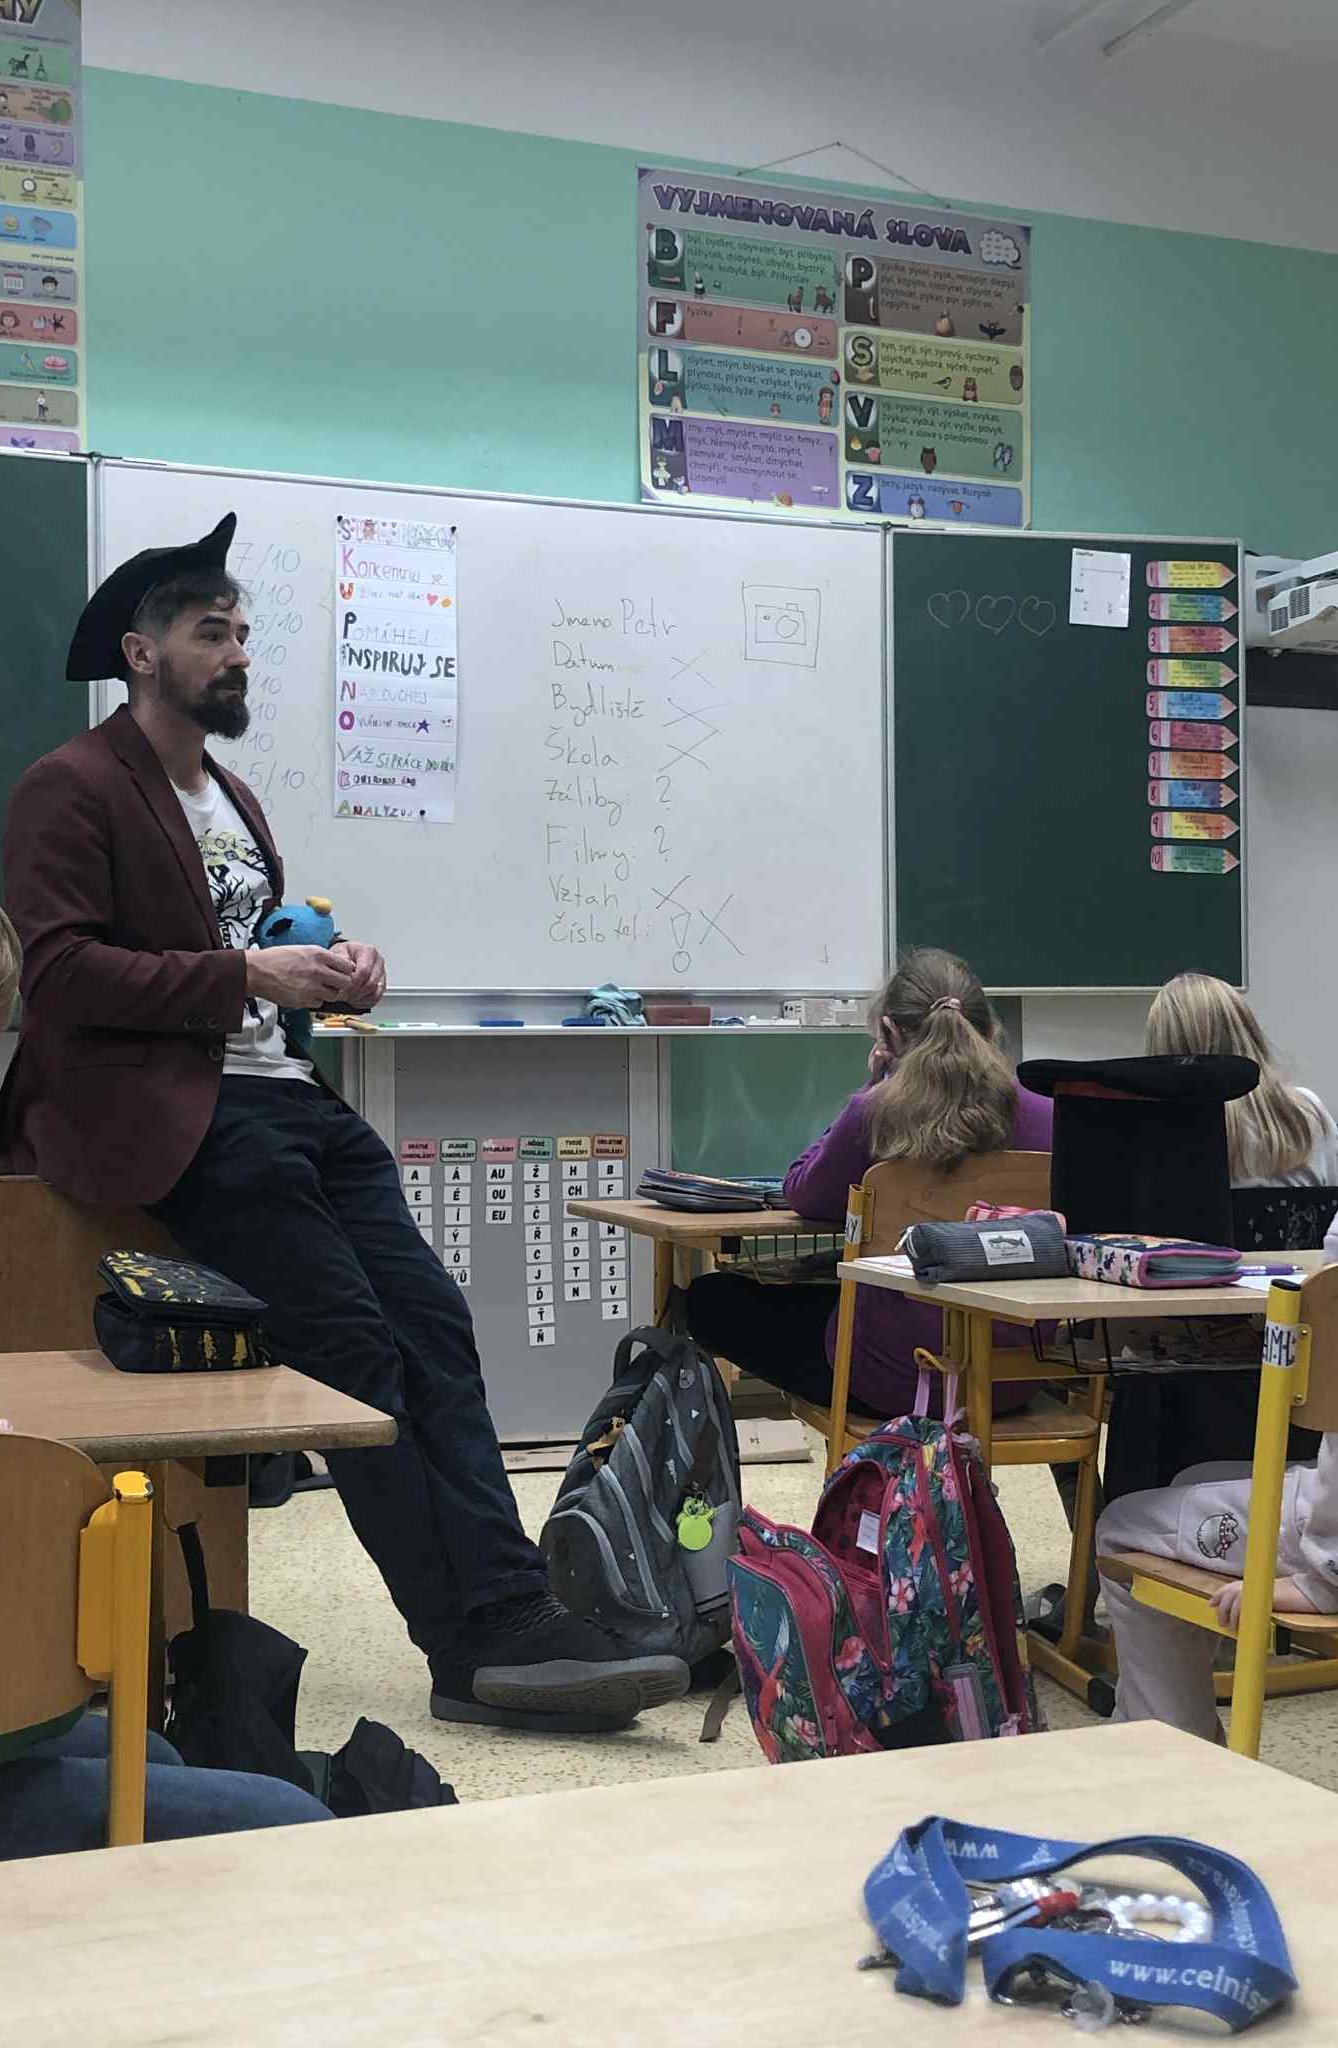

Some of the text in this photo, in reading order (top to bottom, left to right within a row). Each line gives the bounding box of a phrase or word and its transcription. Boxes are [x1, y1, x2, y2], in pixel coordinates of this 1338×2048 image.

[652, 185, 972, 254] VYJMENOVANÁ SLOVA
[655, 229, 679, 261] B
[852, 257, 874, 289] P
[656, 301, 677, 334] F
[851, 335, 874, 367] S
[658, 349, 678, 382] L
[848, 394, 875, 428] V
[652, 418, 684, 451] M
[852, 474, 874, 506] Z
[235, 542, 302, 576] 7/10
[621, 597, 678, 638] Petr
[429, 655, 456, 678] SE
[551, 682, 647, 727] Bydliště
[411, 1170, 419, 1181] A
[452, 1168, 460, 1181] Á
[491, 1169, 505, 1180] AU
[533, 1165, 539, 1177] Ž
[569, 1165, 577, 1176] H
[607, 1165, 613, 1175] B
[414, 1191, 422, 1201] E
[453, 1188, 460, 1201] É
[492, 1189, 506, 1200] OU
[534, 1186, 540, 1199] Š
[568, 1185, 582, 1196] CH
[607, 1185, 613, 1194] F
[417, 1211, 421, 1222] I
[456, 1208, 460, 1222] Í
[492, 1210, 506, 1221] EU
[533, 1206, 540, 1219] Č
[452, 1229, 460, 1242] Ý
[534, 1227, 541, 1240] Ř
[571, 1227, 578, 1238] R
[453, 1250, 460, 1263] Ó
[534, 1249, 541, 1260] C
[573, 1246, 580, 1257] D
[610, 1246, 616, 1256] P
[534, 1270, 541, 1280] J
[573, 1267, 580, 1277] T
[609, 1266, 615, 1276] S
[536, 1287, 543, 1300] Ď
[572, 1287, 580, 1297] N
[610, 1286, 617, 1296] V
[537, 1308, 545, 1321] Ť
[612, 1305, 618, 1315] Z
[537, 1329, 544, 1342] Ň
